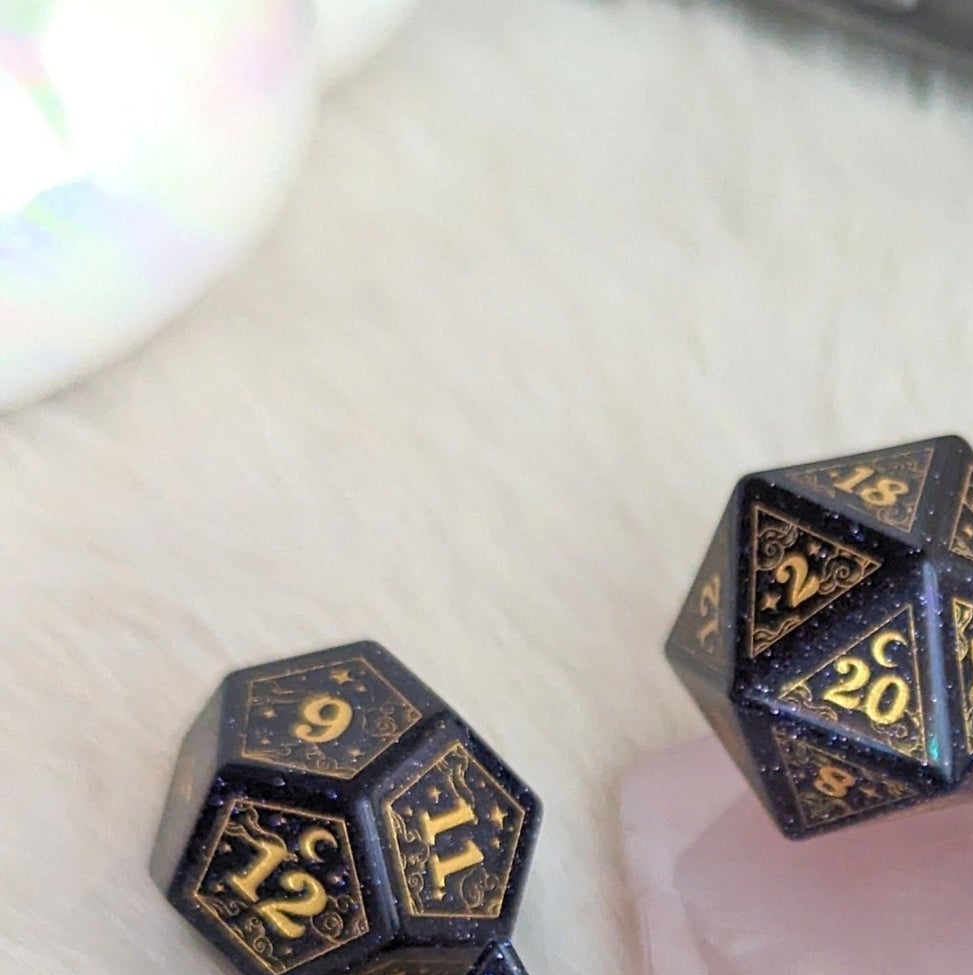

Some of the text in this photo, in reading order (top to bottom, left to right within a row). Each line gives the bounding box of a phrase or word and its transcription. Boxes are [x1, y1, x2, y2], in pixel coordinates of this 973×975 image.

[833, 466, 909, 507] 18
[776, 556, 820, 607] 2
[823, 656, 910, 725] 20
[294, 697, 354, 743] 9
[814, 765, 857, 797] 8
[419, 800, 486, 889] 11
[226, 840, 328, 939] 12
